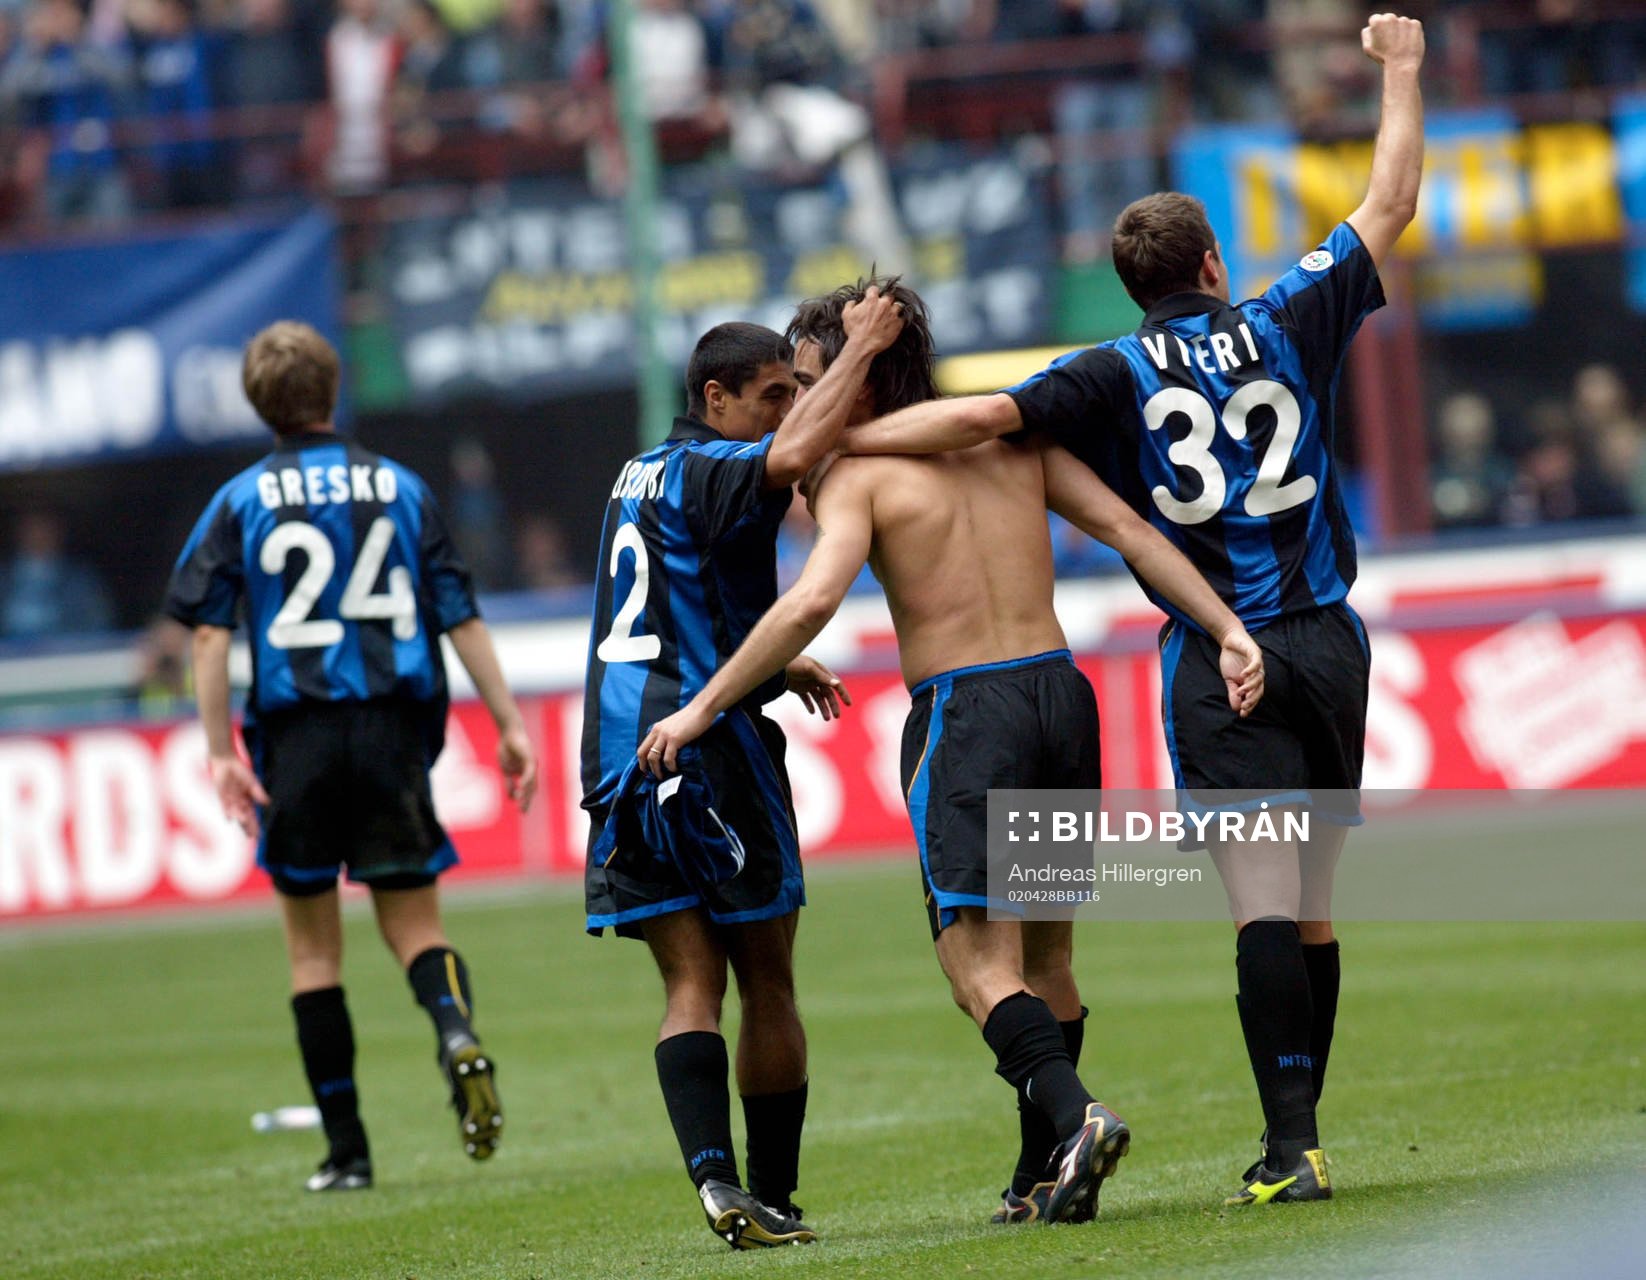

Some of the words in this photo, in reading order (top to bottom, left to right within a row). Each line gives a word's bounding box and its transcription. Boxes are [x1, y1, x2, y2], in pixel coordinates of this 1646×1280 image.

[1141, 323, 1259, 373] VIERI
[257, 464, 397, 509] GRESKO
[1143, 380, 1317, 525] 32
[260, 516, 417, 649] 24
[597, 522, 661, 662] 2
[691, 1149, 725, 1168] INTER
